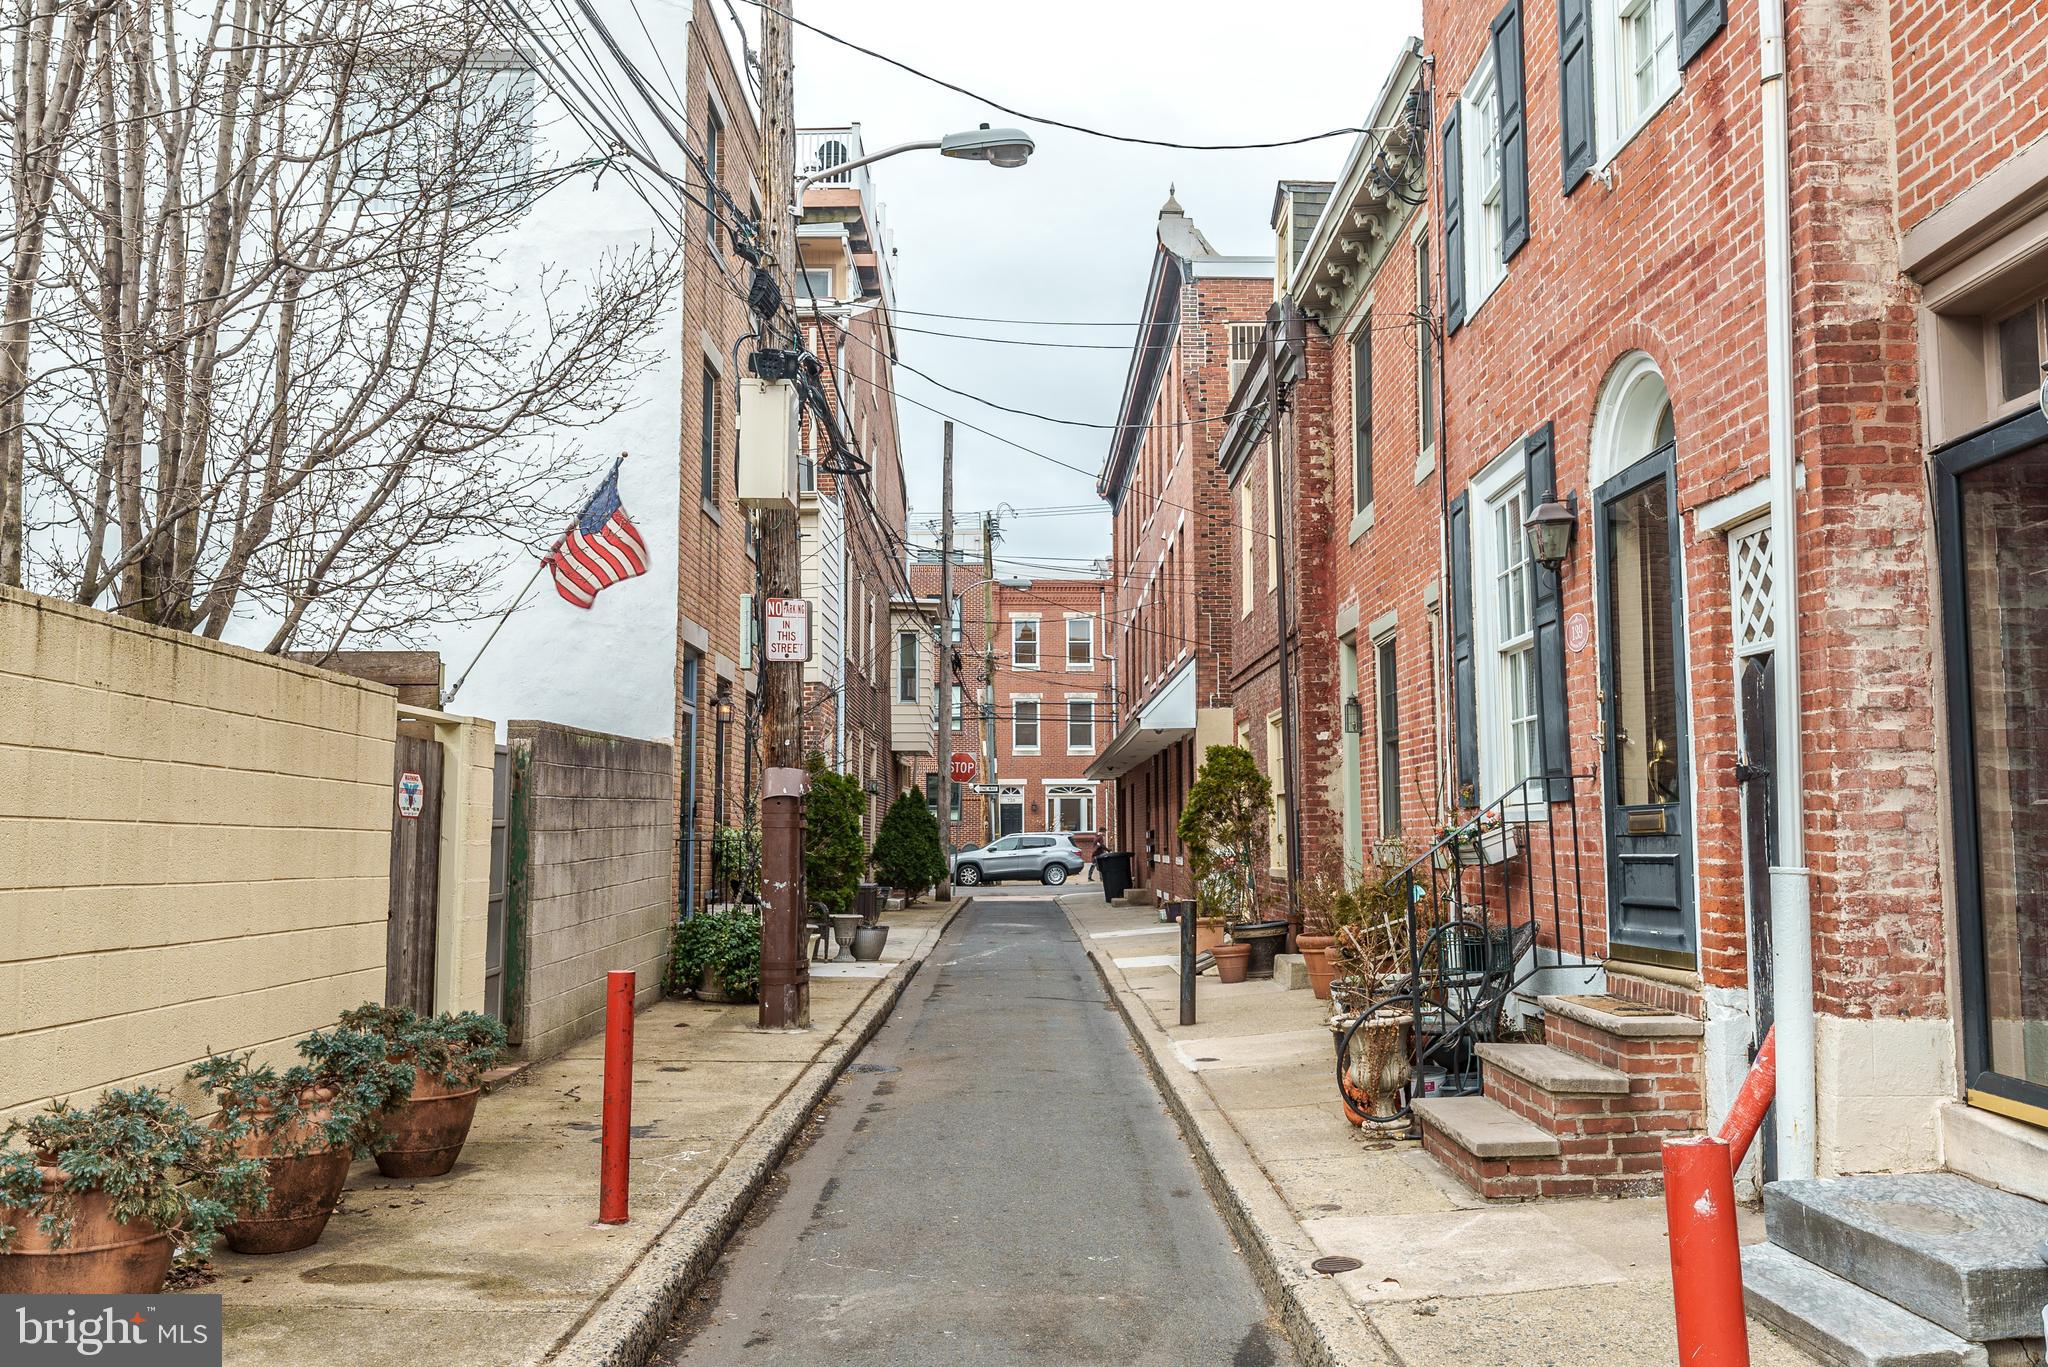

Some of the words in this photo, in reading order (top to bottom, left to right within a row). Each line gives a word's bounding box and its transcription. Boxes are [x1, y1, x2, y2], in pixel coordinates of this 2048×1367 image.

[768, 601, 782, 616] NO
[784, 604, 805, 614] PARKING
[782, 620, 791, 629] IN
[777, 631, 797, 641] THIS
[771, 642, 804, 654] STREET
[951, 762, 975, 774] STOP
